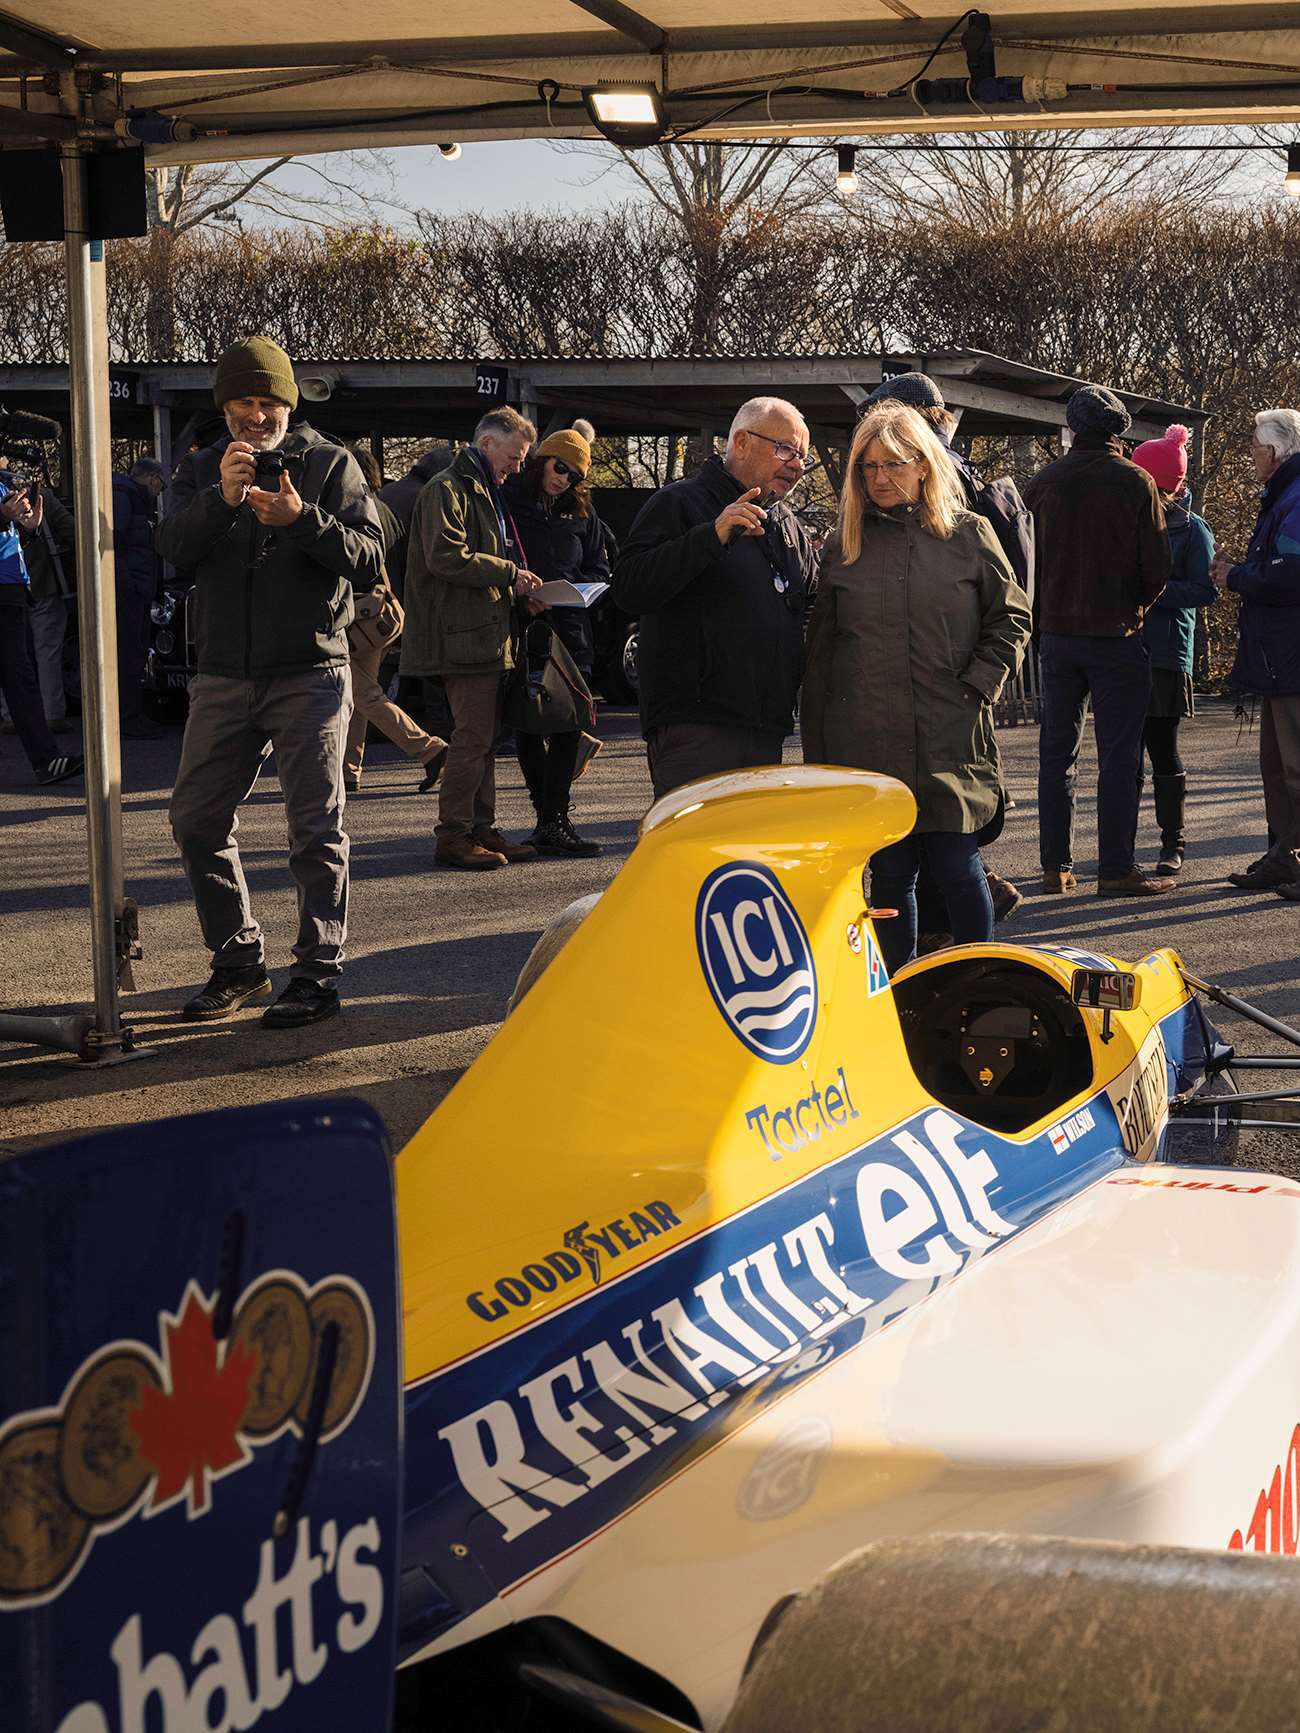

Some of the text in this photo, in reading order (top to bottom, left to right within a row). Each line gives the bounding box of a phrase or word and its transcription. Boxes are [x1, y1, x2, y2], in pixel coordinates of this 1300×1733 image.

[476, 375, 500, 395] 237
[709, 896, 793, 985] ICI
[745, 1067, 860, 1161] Tactel
[855, 1109, 1019, 1282] elf
[439, 1212, 873, 1543] RENAULT
[57, 1517, 384, 1733] batt's
